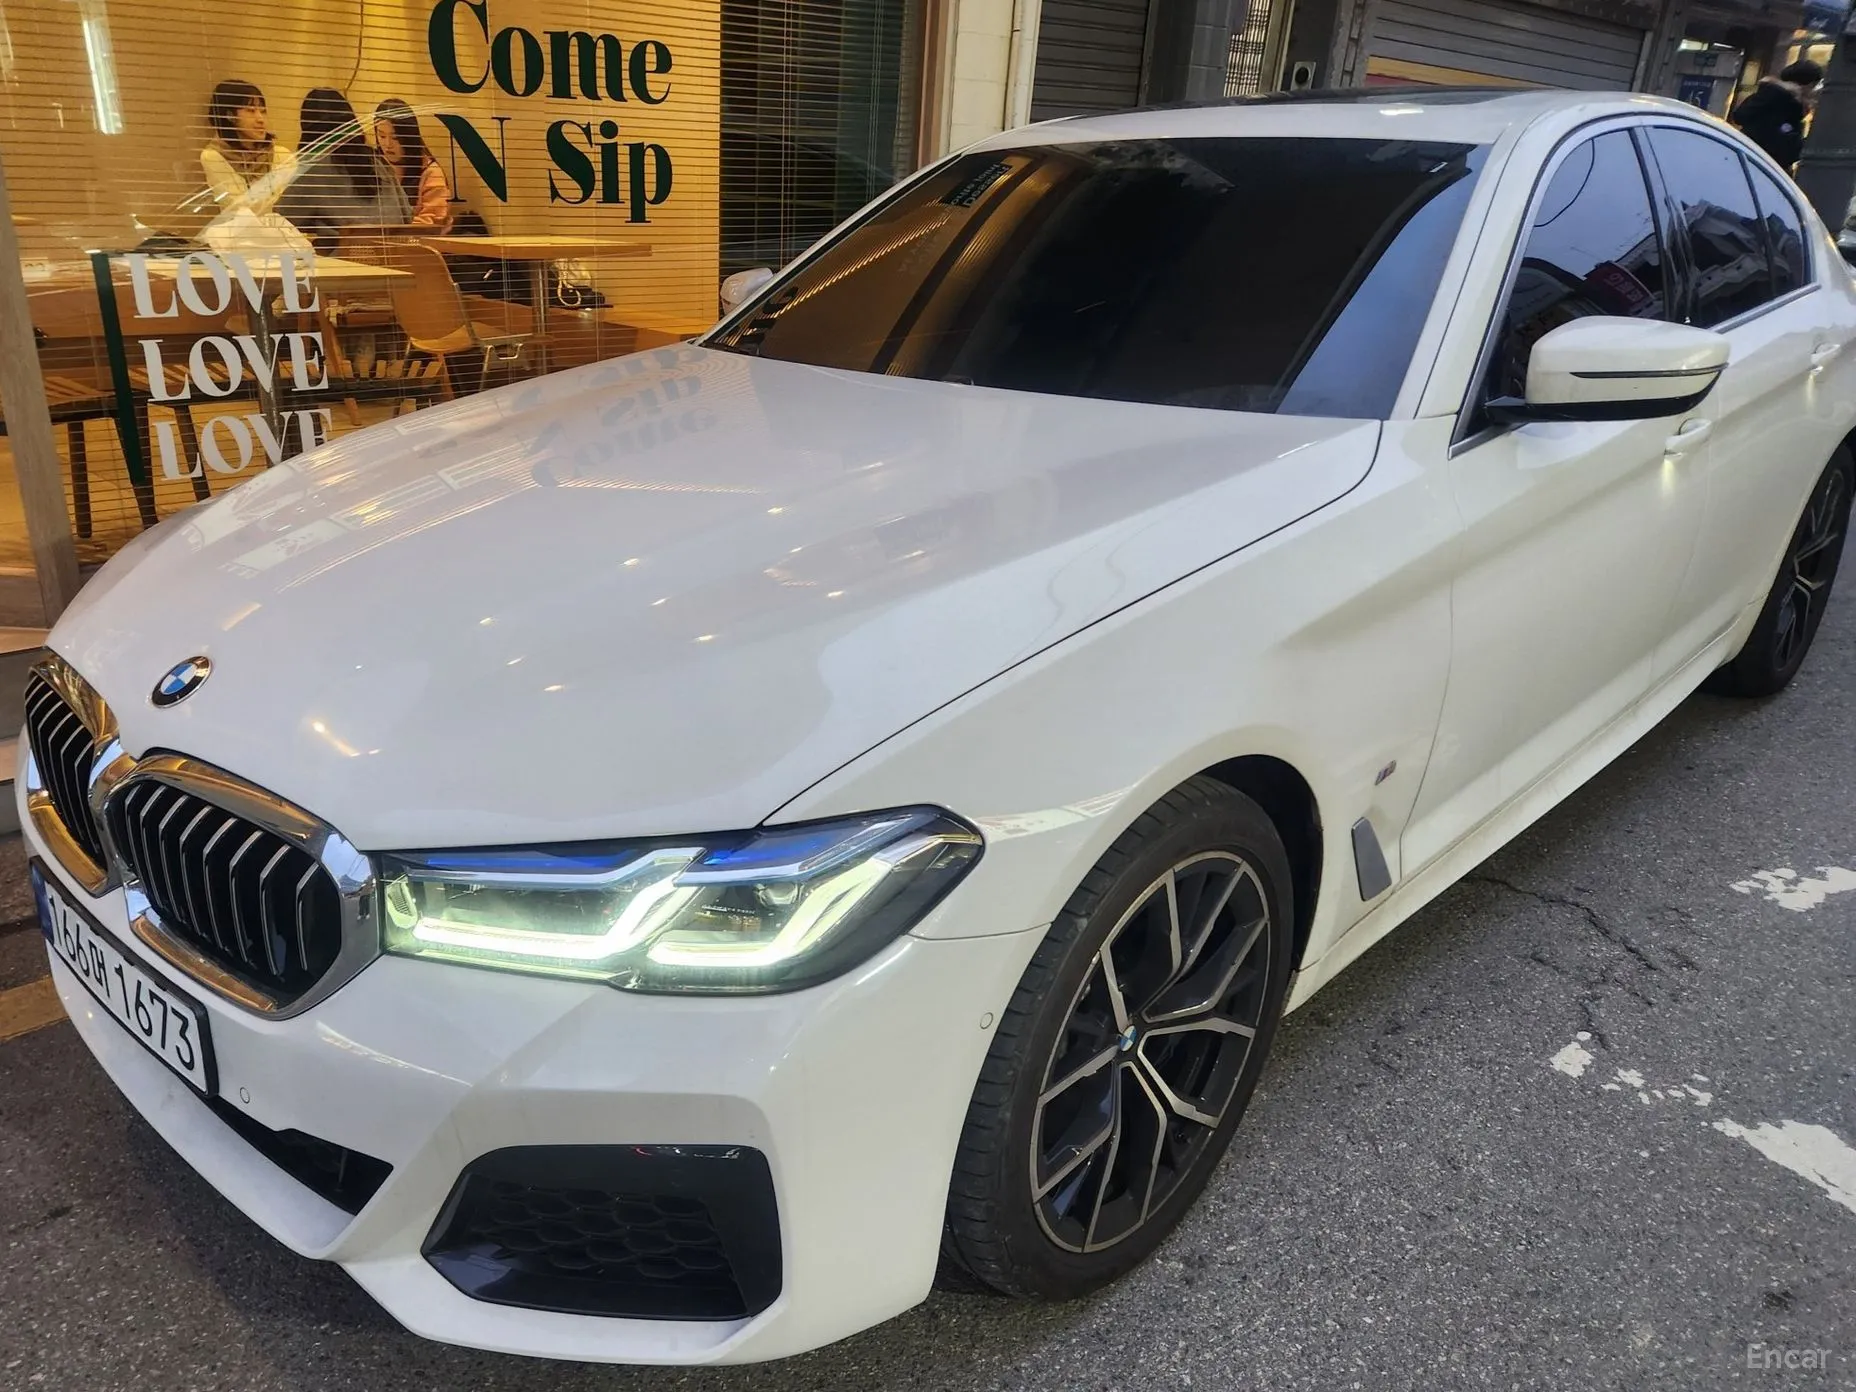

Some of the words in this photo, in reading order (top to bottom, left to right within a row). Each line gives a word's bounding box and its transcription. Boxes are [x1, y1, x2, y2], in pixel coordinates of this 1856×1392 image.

[428, 0, 673, 105] Come
[434, 113, 512, 203] N
[546, 119, 673, 223] Sip
[123, 251, 321, 319] LOVE
[138, 331, 329, 402] LOVE
[152, 408, 333, 481] LOVE
